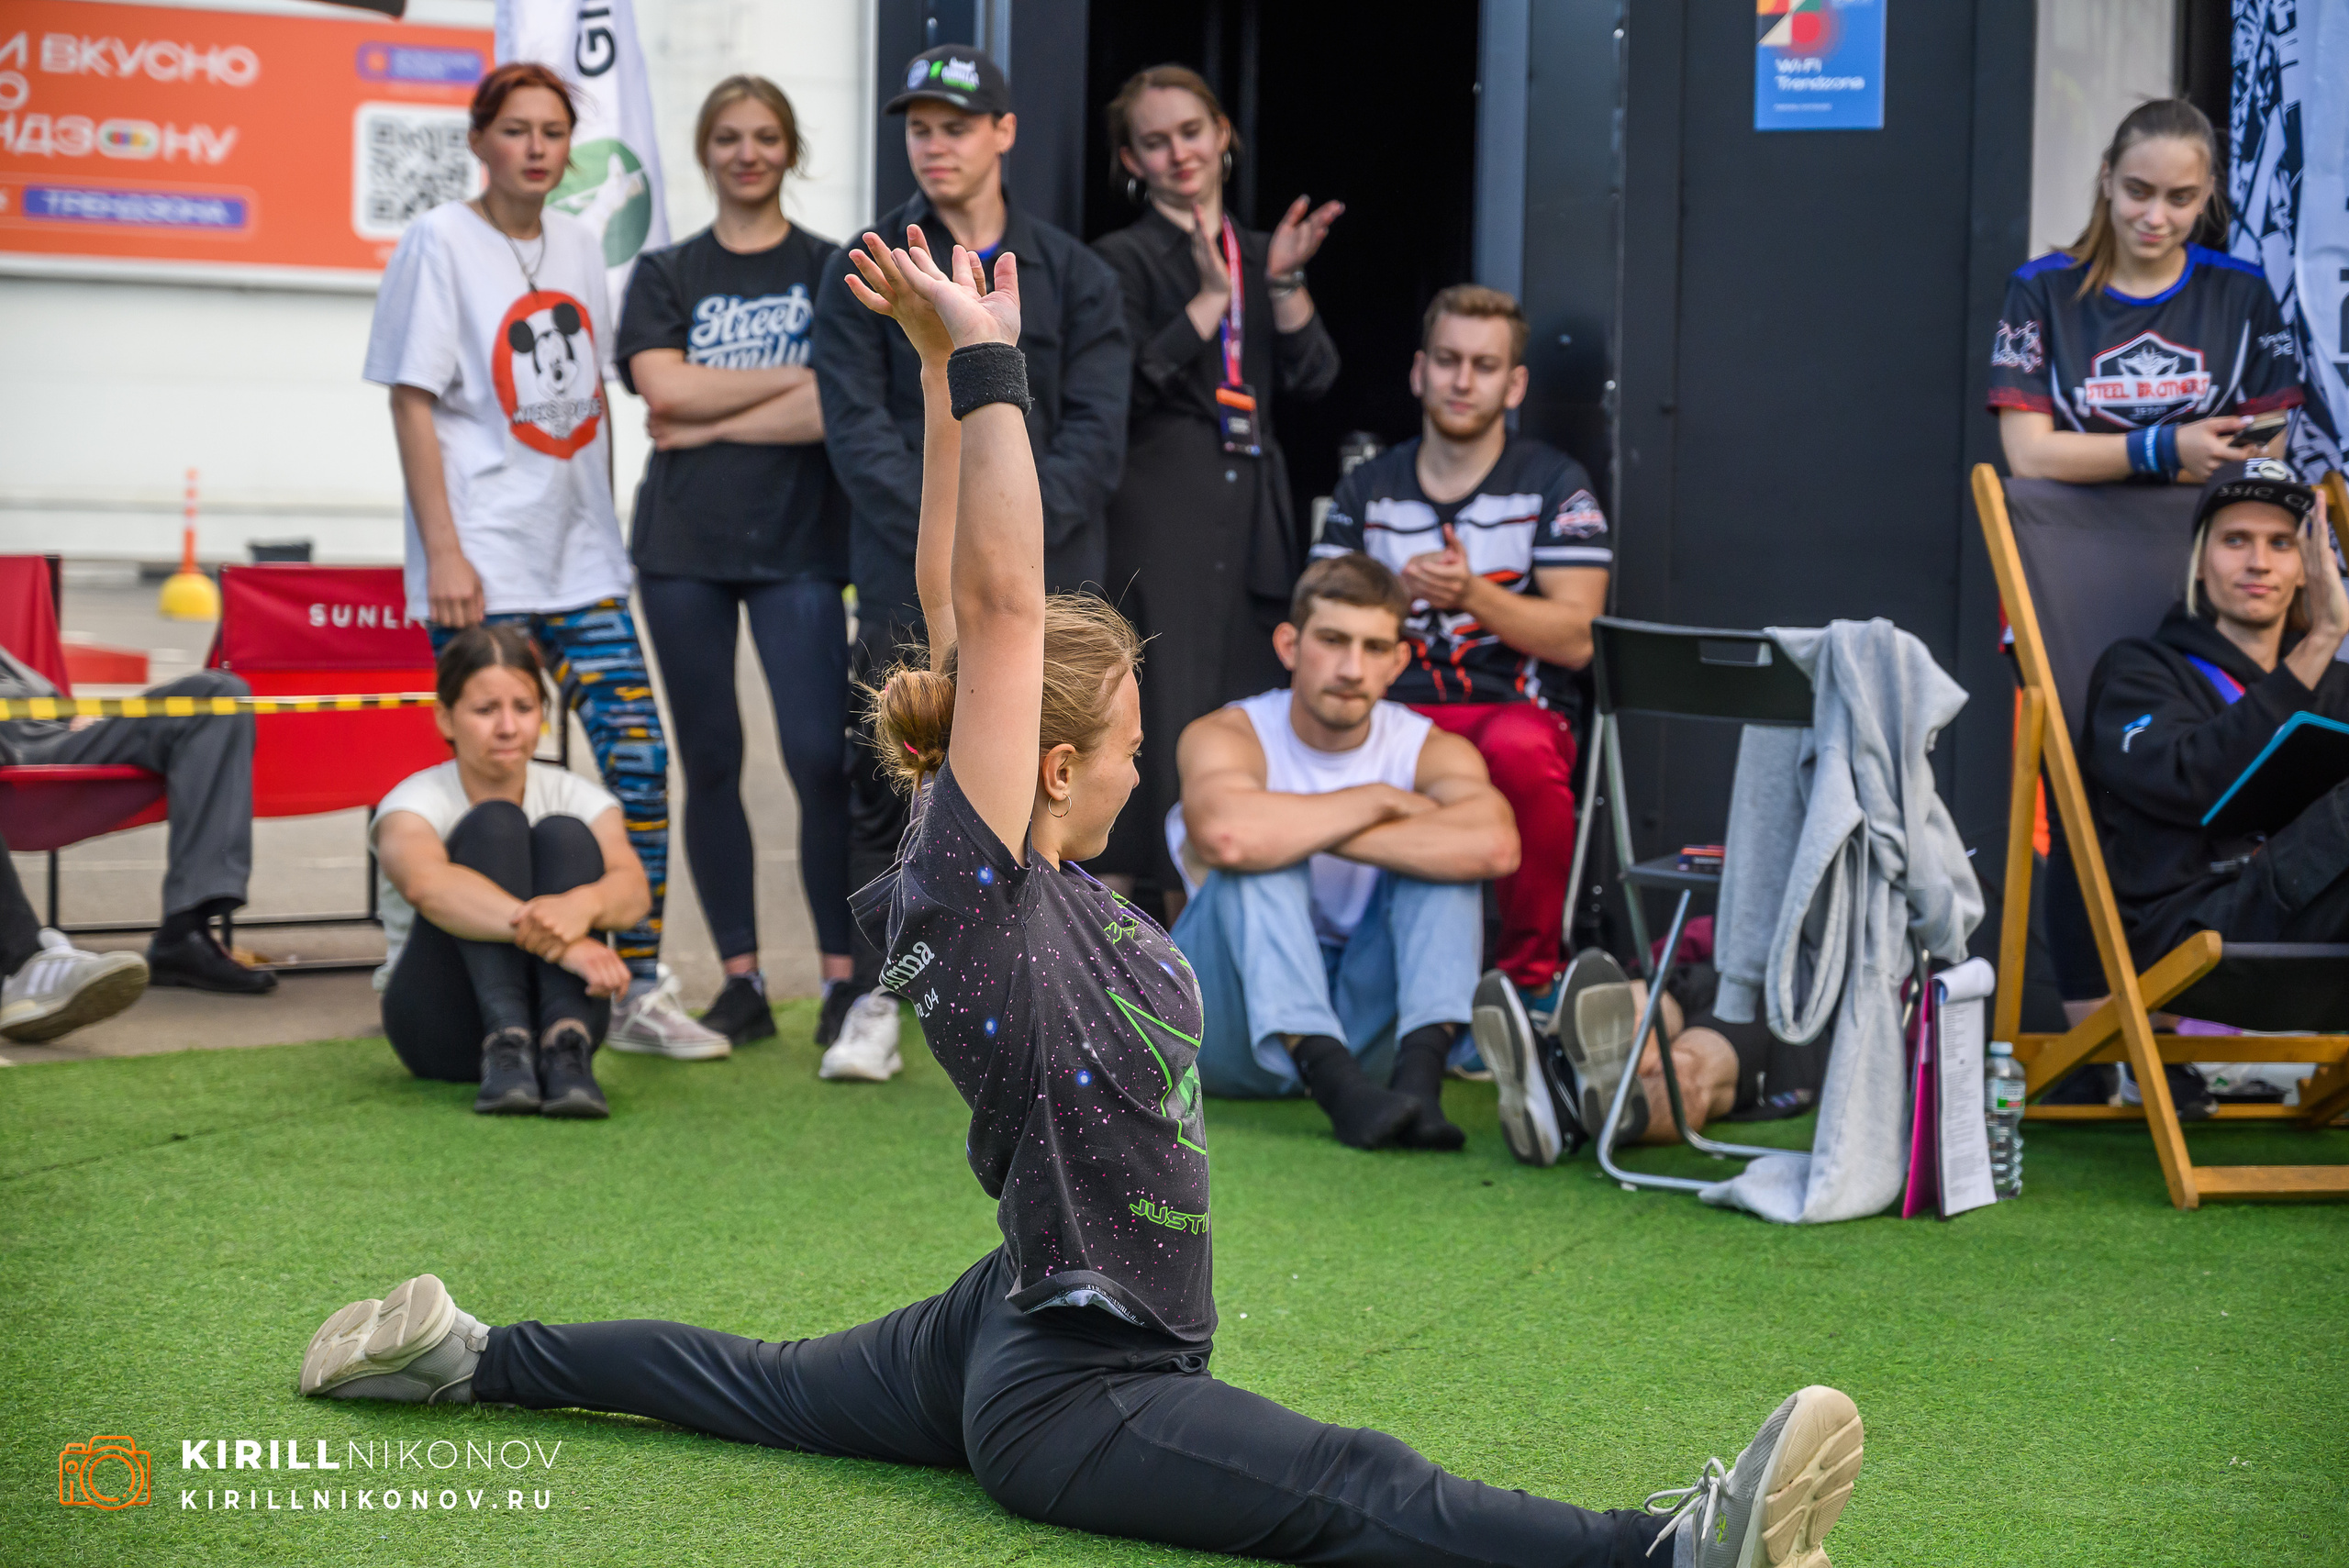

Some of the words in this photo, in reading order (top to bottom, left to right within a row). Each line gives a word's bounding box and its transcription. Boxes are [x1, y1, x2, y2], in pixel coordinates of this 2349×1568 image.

[40, 32, 259, 87] ВКУСНО
[690, 284, 814, 348] Street
[2087, 383, 2131, 401] STEEL
